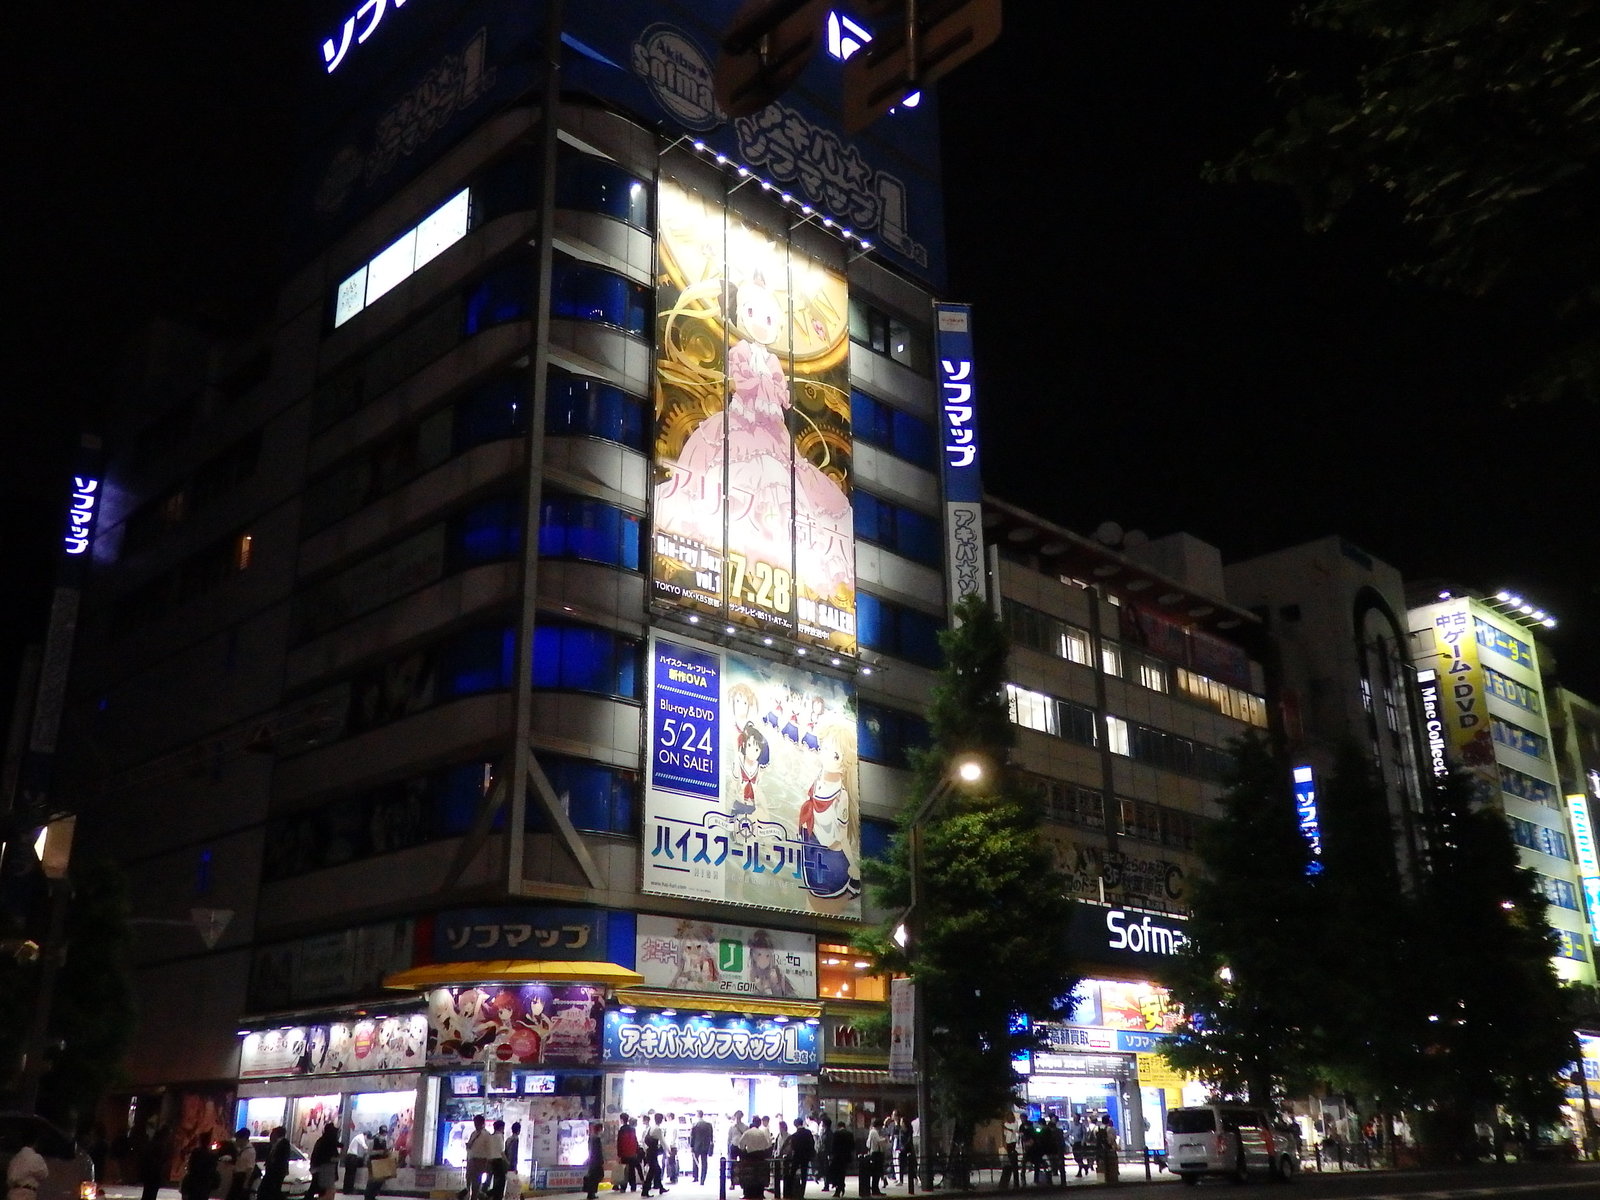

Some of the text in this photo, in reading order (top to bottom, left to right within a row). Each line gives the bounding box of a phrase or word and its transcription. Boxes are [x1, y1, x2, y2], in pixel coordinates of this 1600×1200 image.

[323, 0, 407, 73] ソフ
[941, 360, 976, 467] ソフマップ
[65, 477, 98, 554] ソフマップ
[655, 580, 681, 595] TOKYO
[728, 552, 791, 614] 7.28
[660, 698, 715, 722] Blu-ray&DVD
[1421, 686, 1438, 720] Mac
[660, 718, 713, 756] 5/24
[658, 749, 713, 774] ON SALE!
[651, 825, 830, 884] ハイスクール・フリート
[447, 924, 591, 949] ソフマップ
[1106, 910, 1193, 955] Sofma
